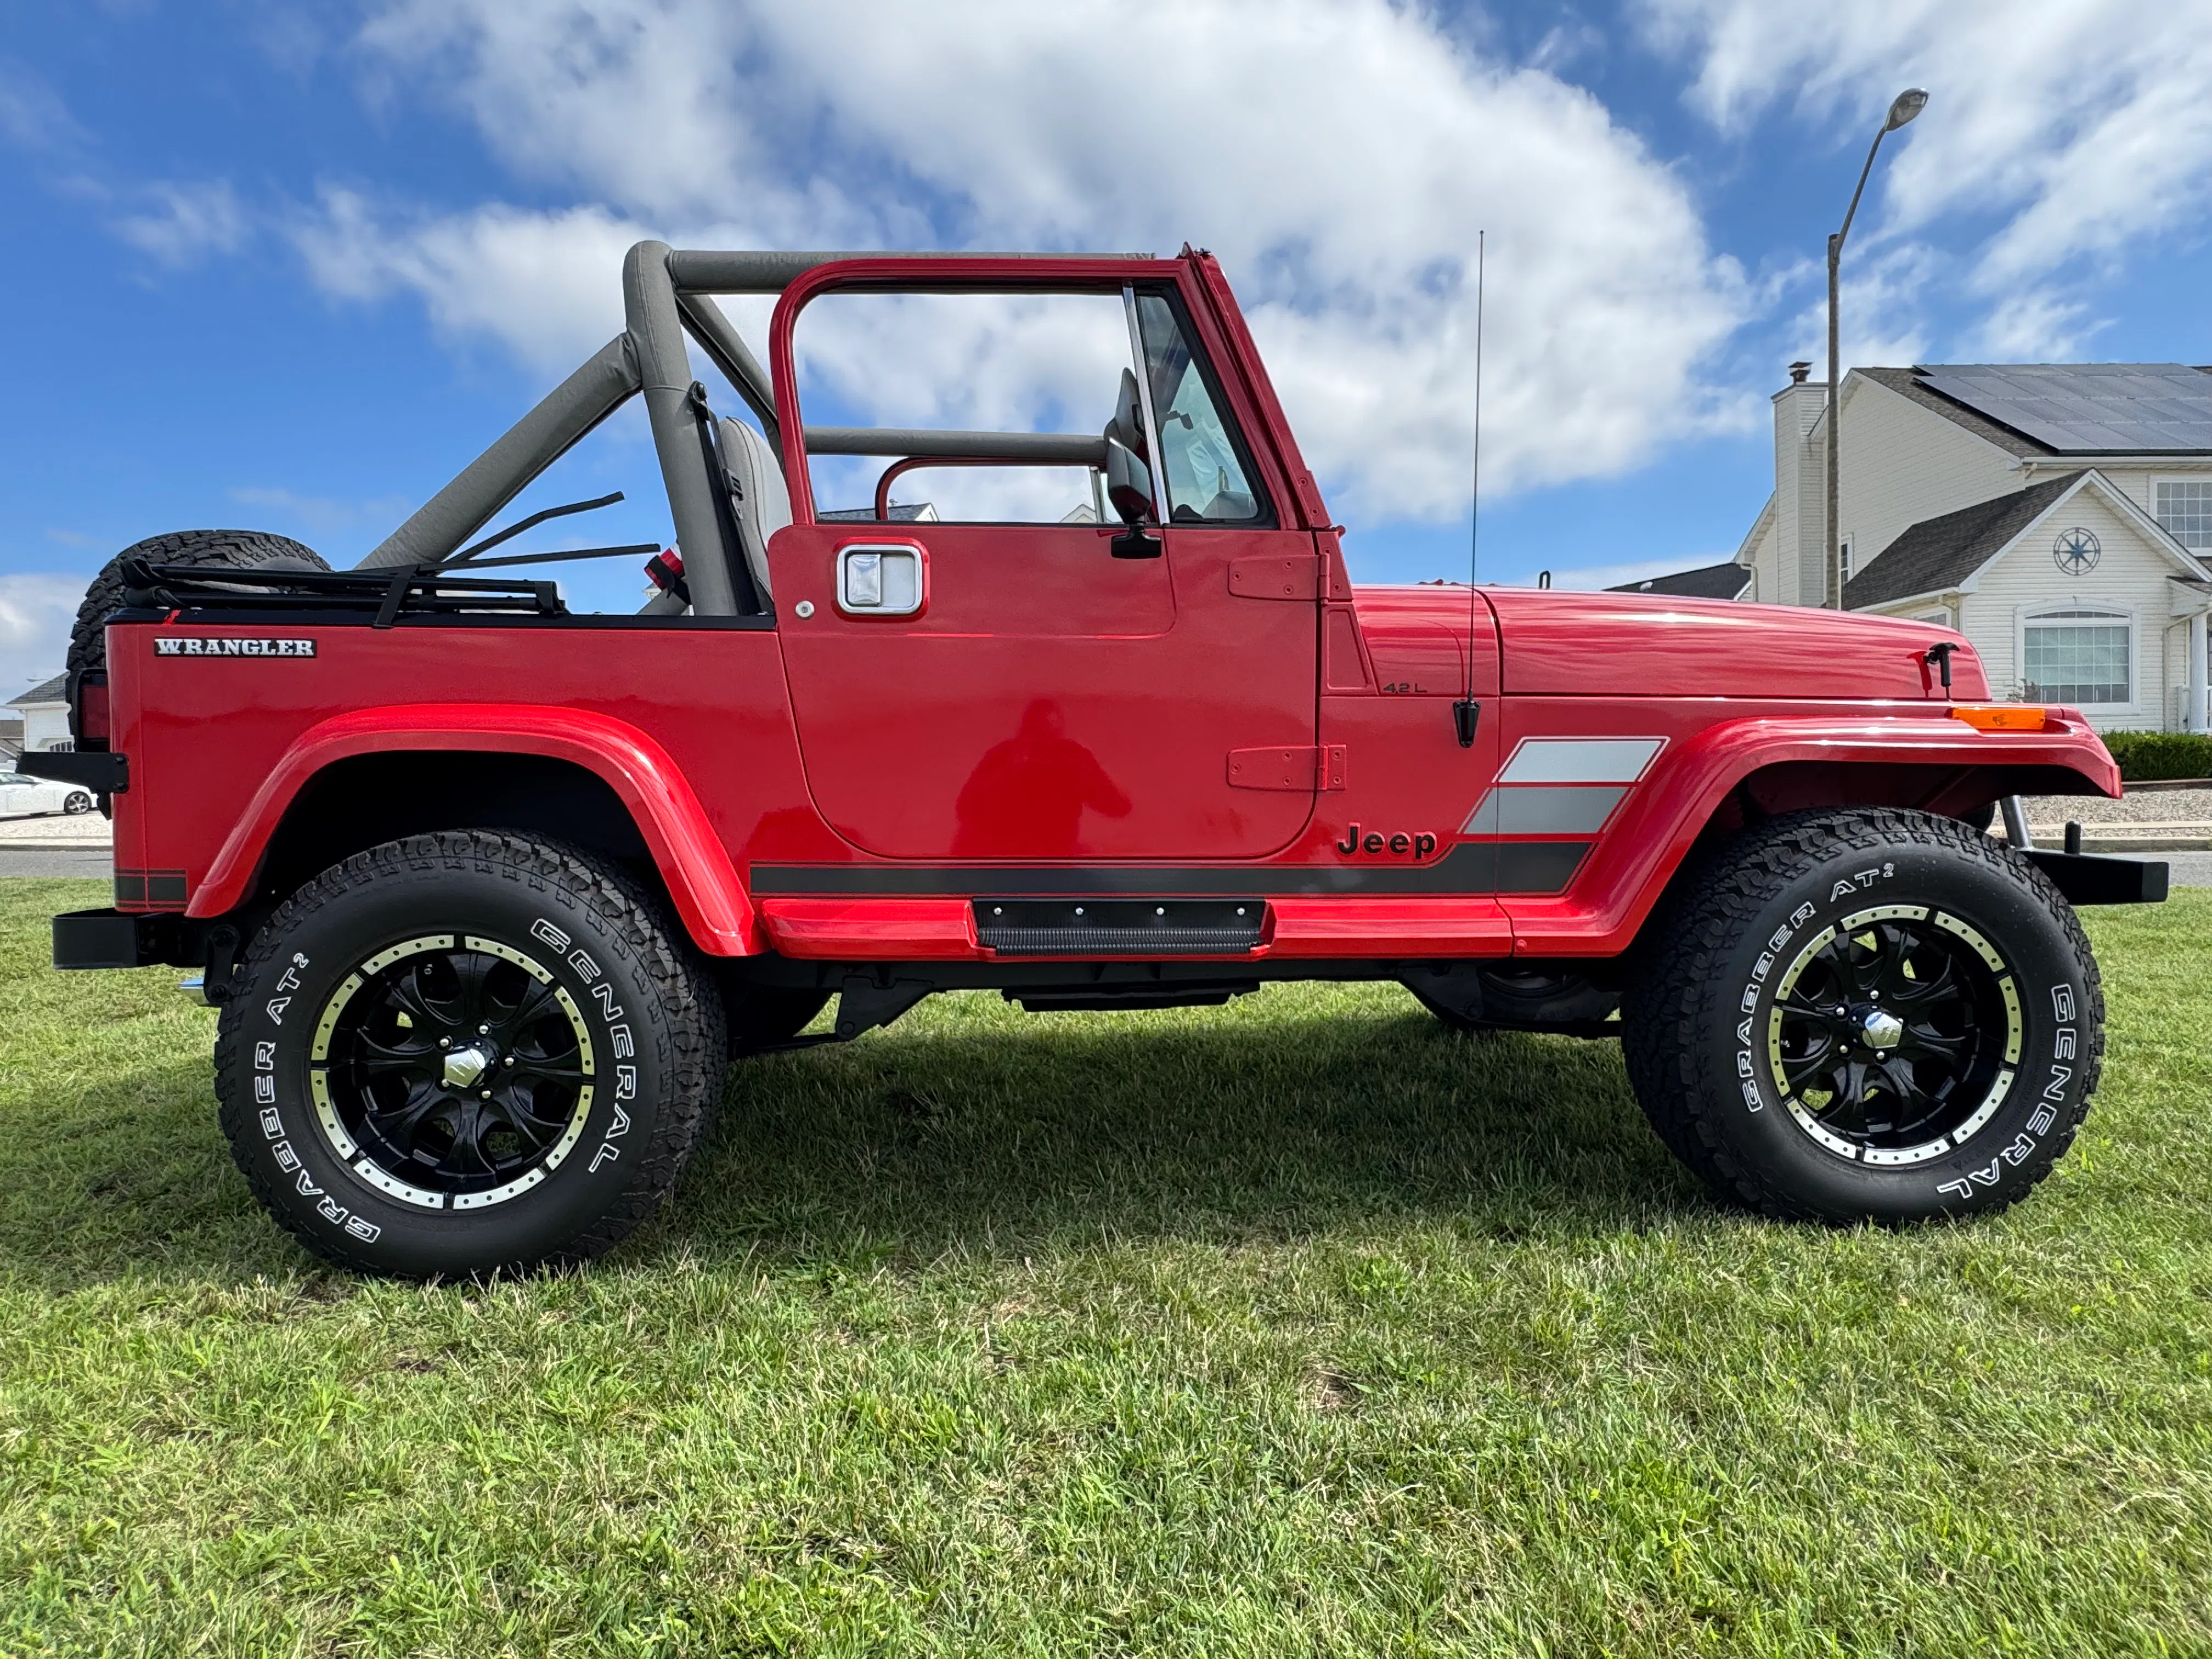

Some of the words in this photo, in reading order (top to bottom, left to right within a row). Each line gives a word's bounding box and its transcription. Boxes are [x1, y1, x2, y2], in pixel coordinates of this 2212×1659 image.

[155, 639, 314, 656] WRANGLER
[1336, 822, 1437, 859] Jeep
[531, 919, 636, 1173] GENERAL
[1737, 901, 1816, 1113] GRABBER
[1936, 984, 2078, 1199] GENERAL
[255, 1041, 381, 1243] GRABBER
